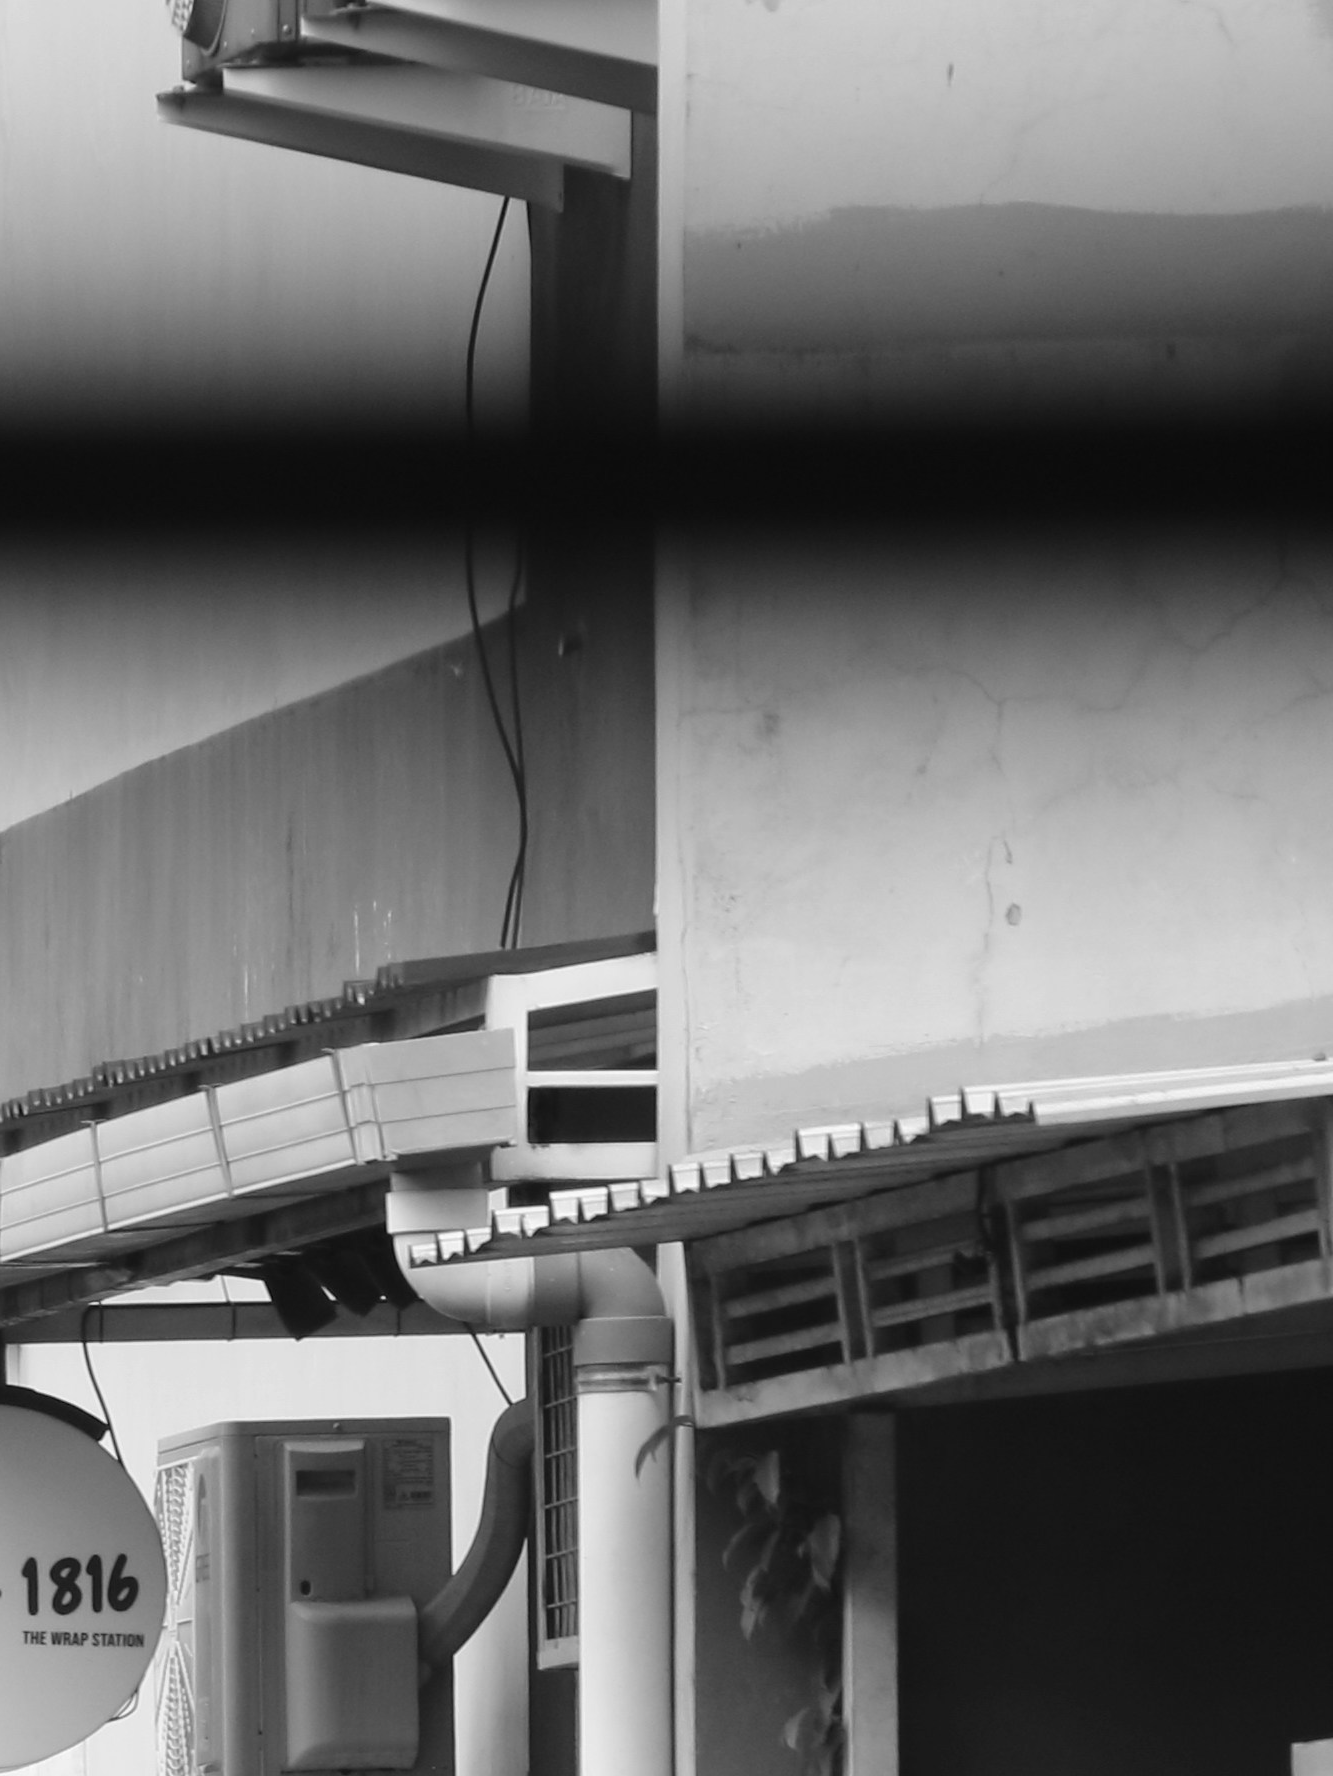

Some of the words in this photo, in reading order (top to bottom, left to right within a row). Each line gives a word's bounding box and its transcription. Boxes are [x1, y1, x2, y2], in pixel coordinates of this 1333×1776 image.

[20, 1552, 141, 1616] 1816
[21, 1630, 47, 1646] THE
[50, 1631, 90, 1647] WRAP
[91, 1632, 146, 1649] STATION
